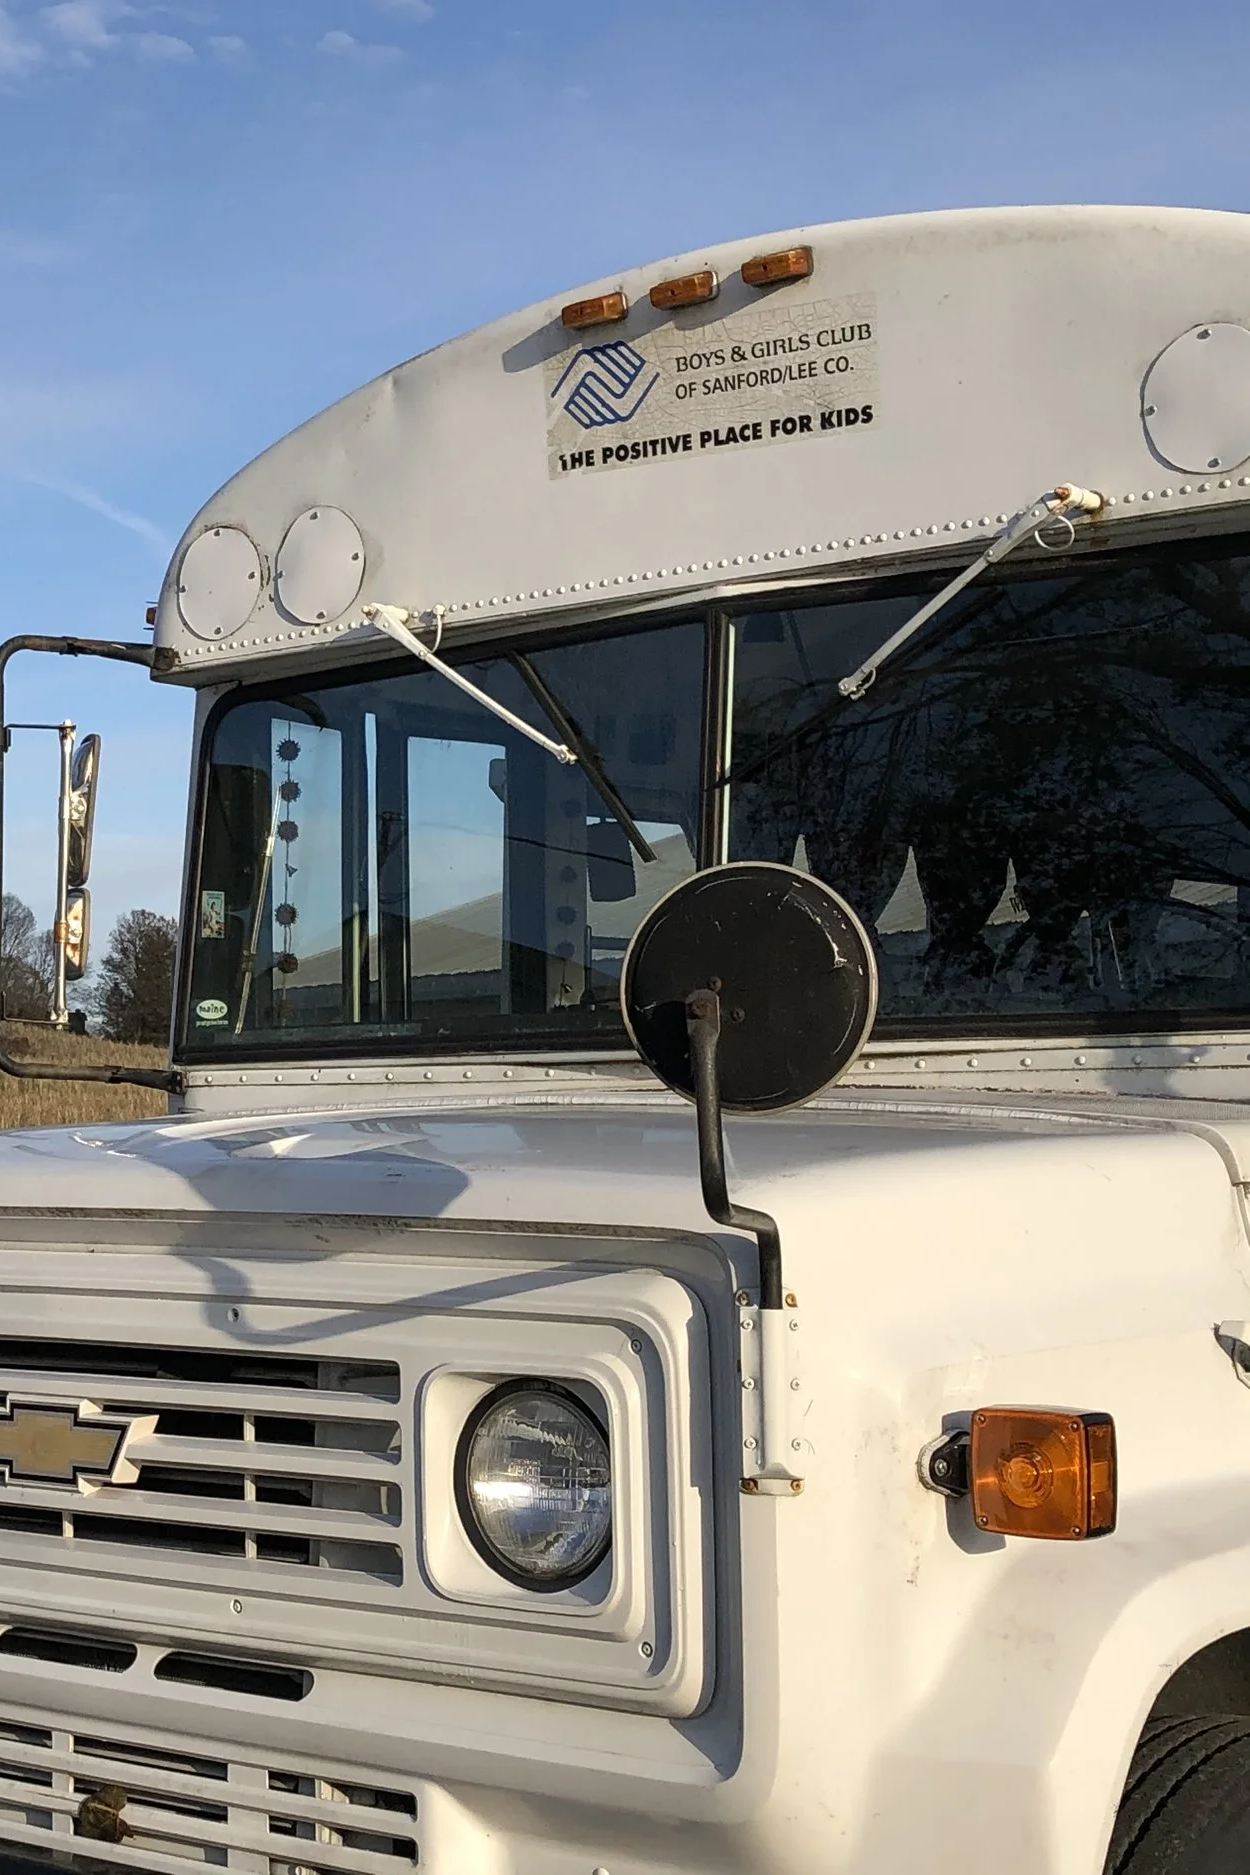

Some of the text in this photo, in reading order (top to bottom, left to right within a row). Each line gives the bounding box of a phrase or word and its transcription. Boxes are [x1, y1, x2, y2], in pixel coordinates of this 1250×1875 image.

[675, 323, 872, 372] BOYS & GIRLS CLUB
[675, 355, 854, 400] OF SANFORD/LEE CO.
[558, 404, 874, 472] THE POSITIVE PLACE FOR KIDS
